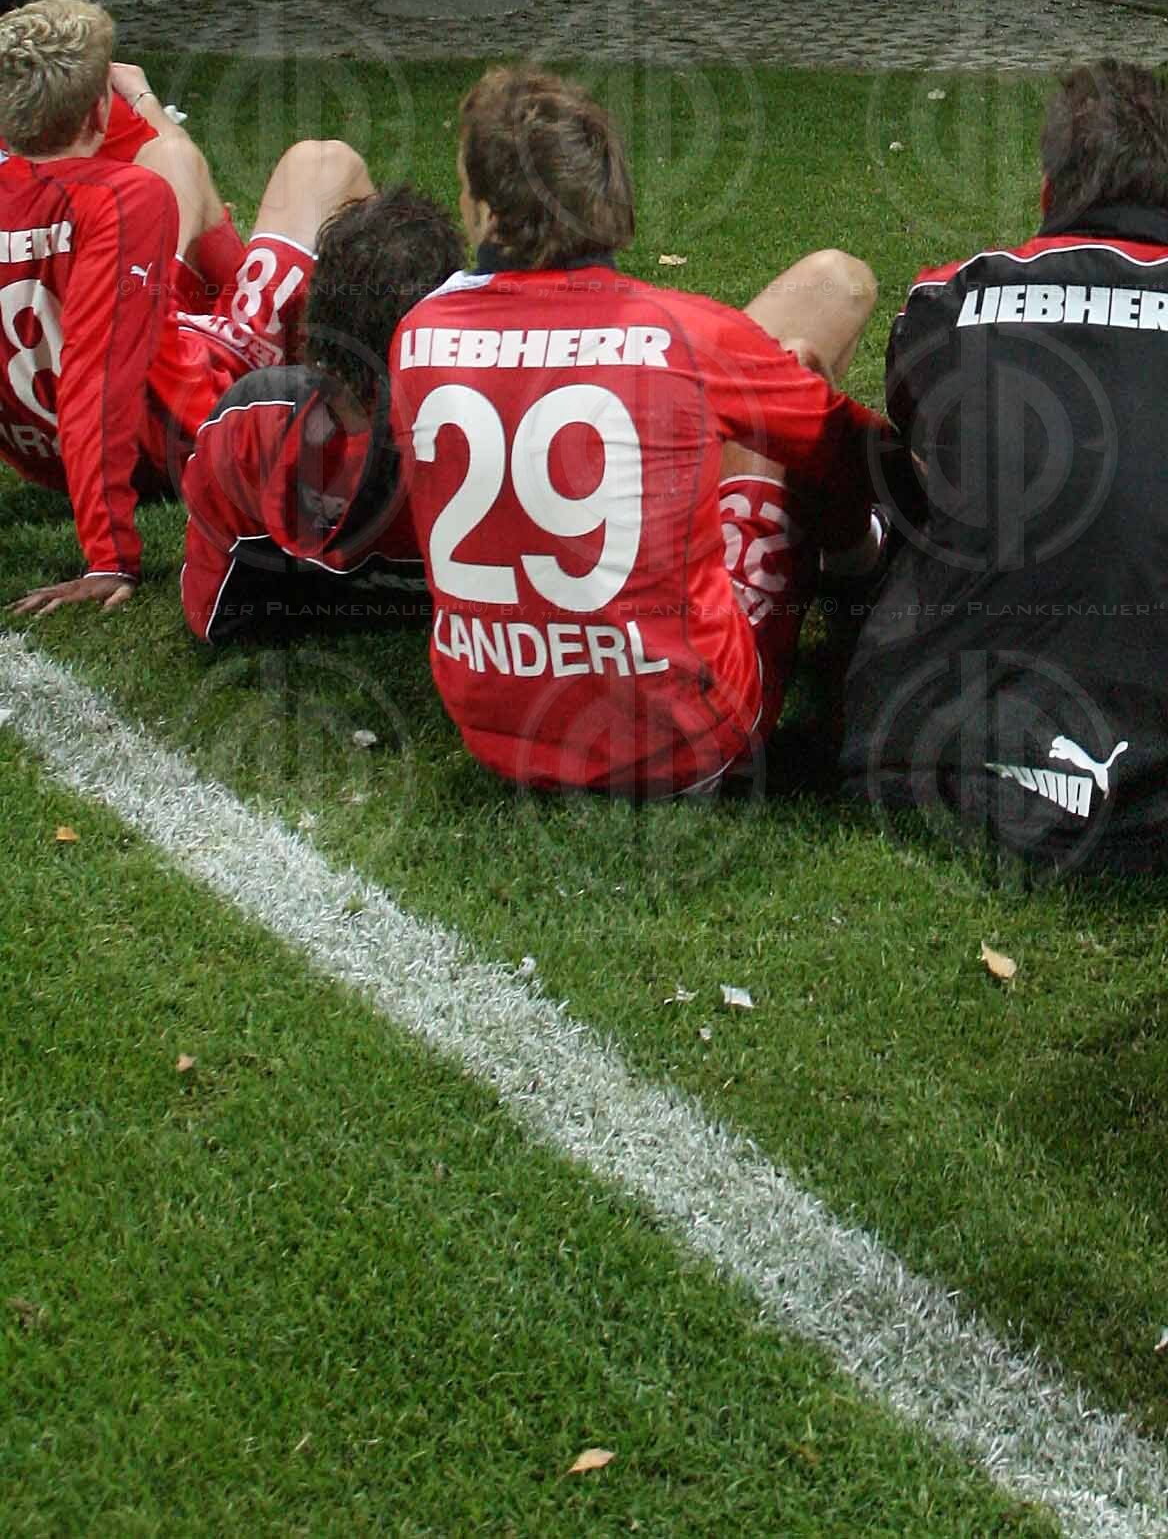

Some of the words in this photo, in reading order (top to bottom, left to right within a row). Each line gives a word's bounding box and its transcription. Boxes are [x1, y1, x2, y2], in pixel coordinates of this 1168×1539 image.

[399, 326, 672, 371] LIEBHERR
[411, 383, 643, 612] 29
[433, 609, 670, 678] LANDERL
